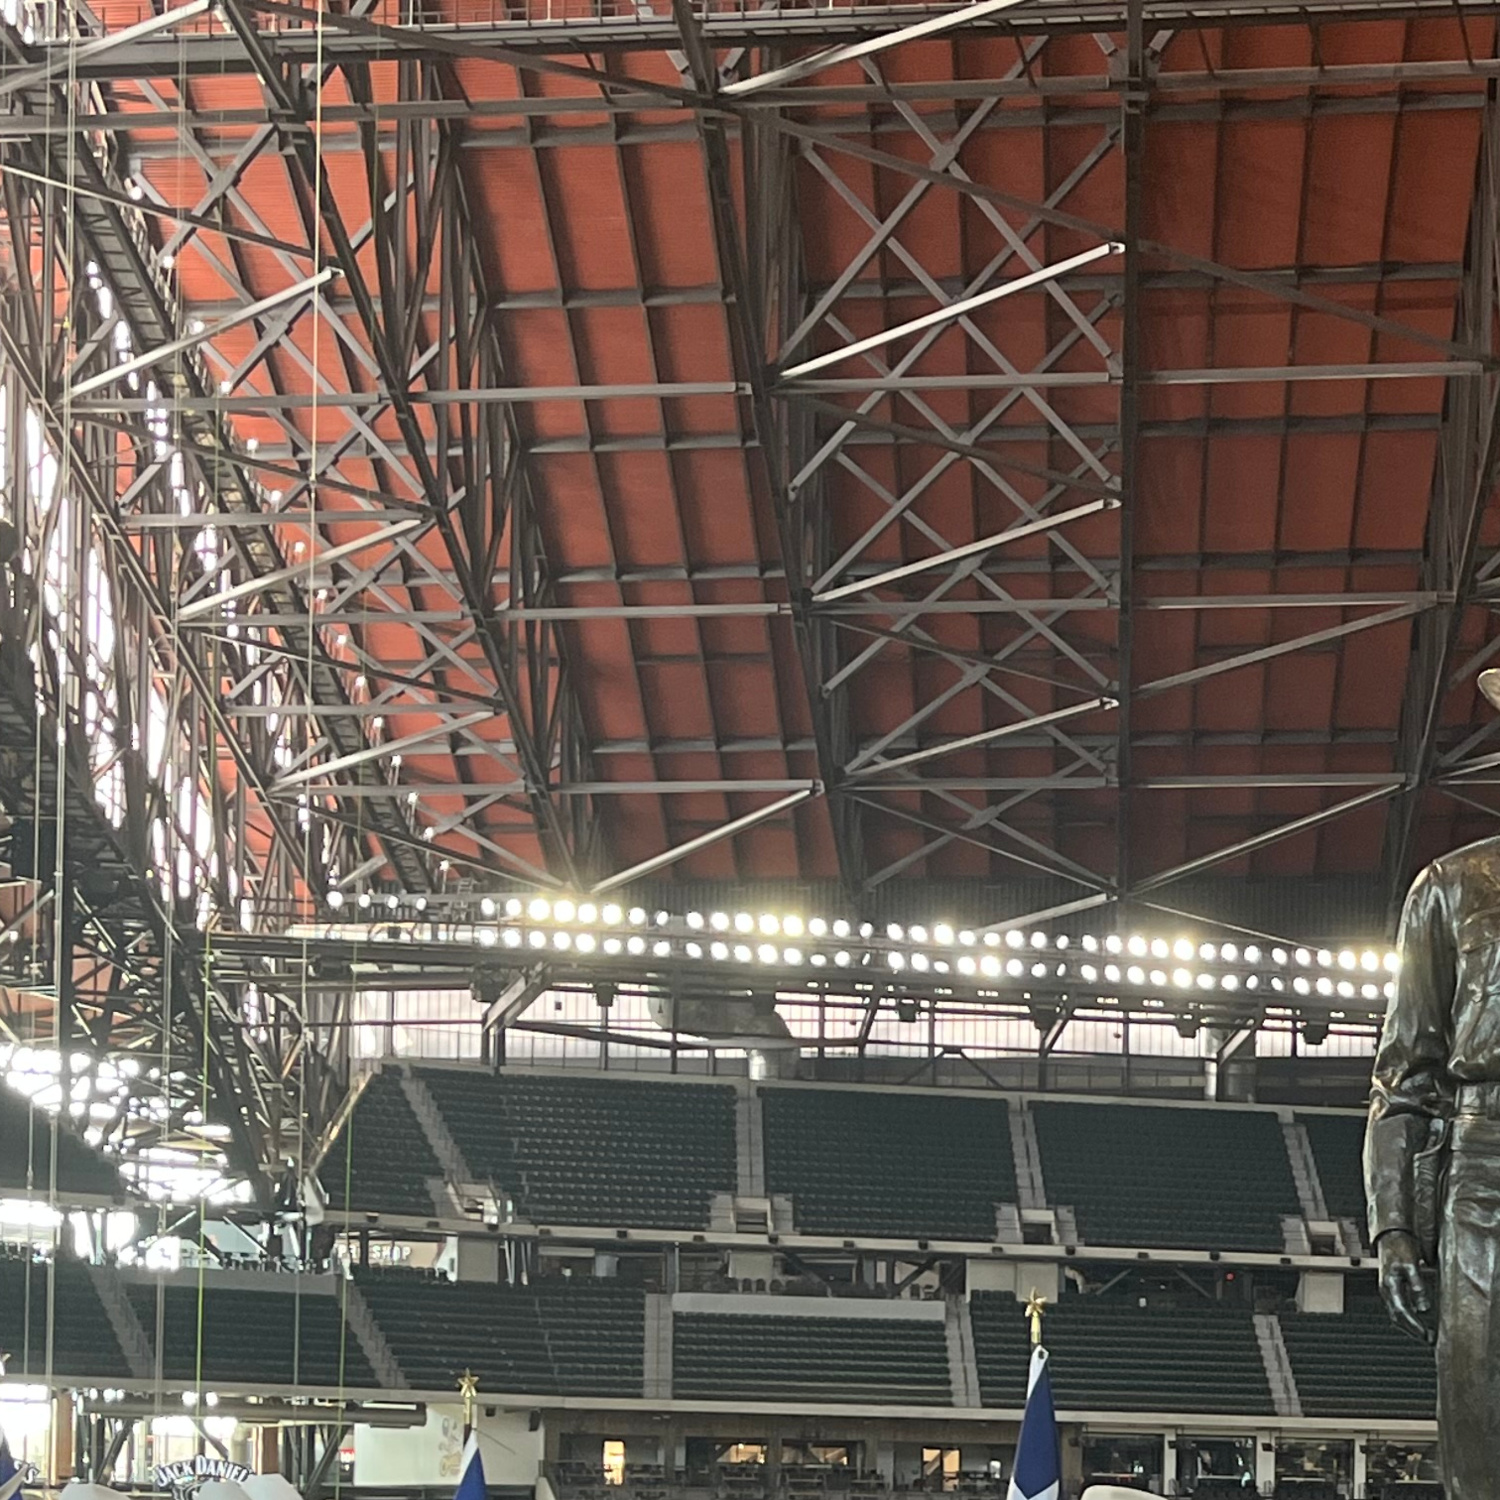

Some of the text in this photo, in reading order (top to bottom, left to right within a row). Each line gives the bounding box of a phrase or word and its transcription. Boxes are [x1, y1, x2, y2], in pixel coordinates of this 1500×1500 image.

[372, 1244, 411, 1261] SHOP
[155, 1455, 249, 1487] JACK DANIEL
